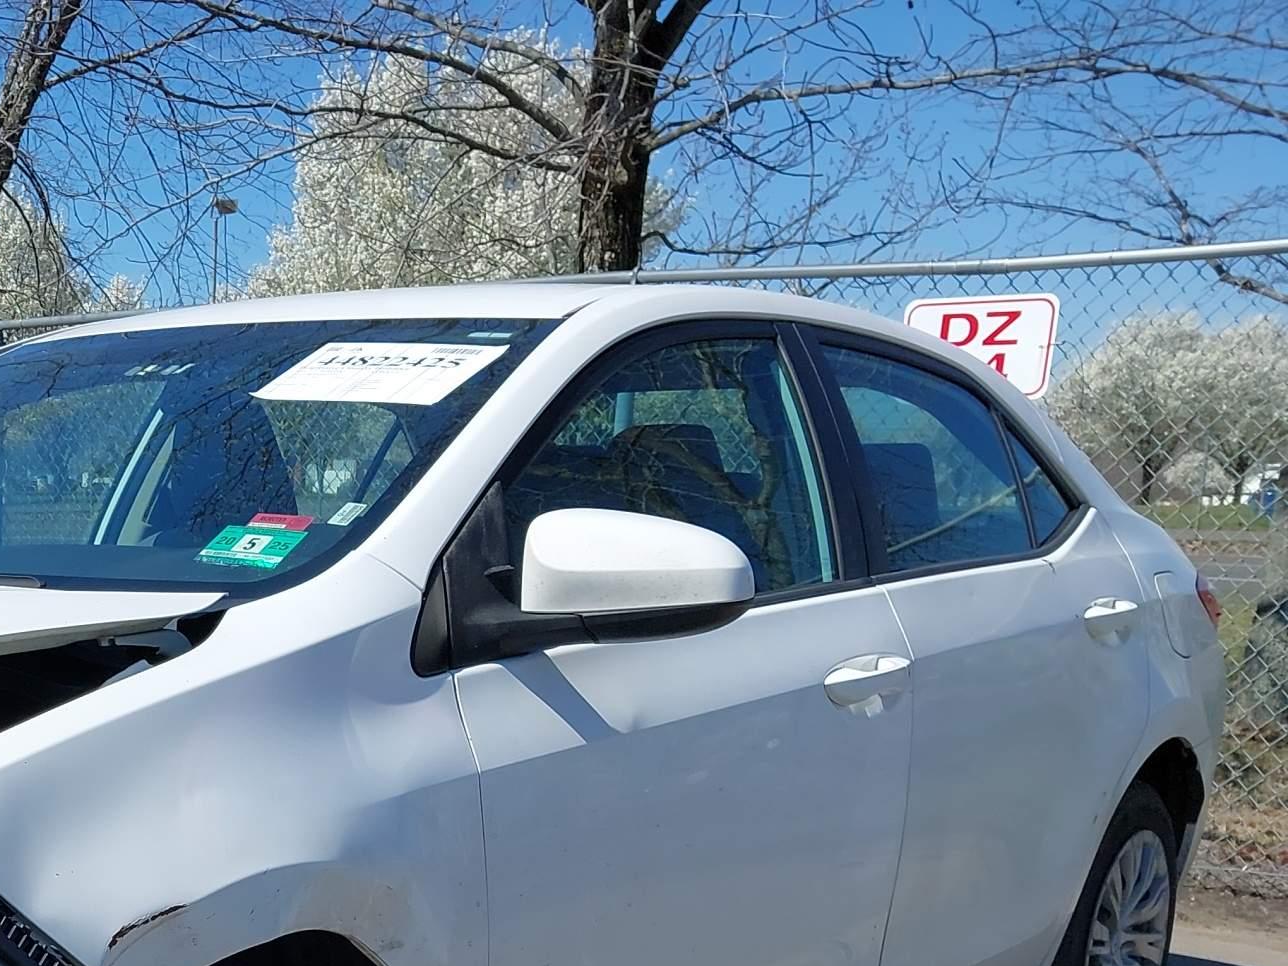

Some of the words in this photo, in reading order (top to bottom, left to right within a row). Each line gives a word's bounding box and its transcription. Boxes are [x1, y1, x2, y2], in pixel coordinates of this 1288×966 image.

[940, 311, 1022, 347] DZ
[319, 355, 467, 369] 44822425
[215, 536, 237, 546] 20
[243, 537, 260, 550] 5
[268, 541, 291, 551] 25
